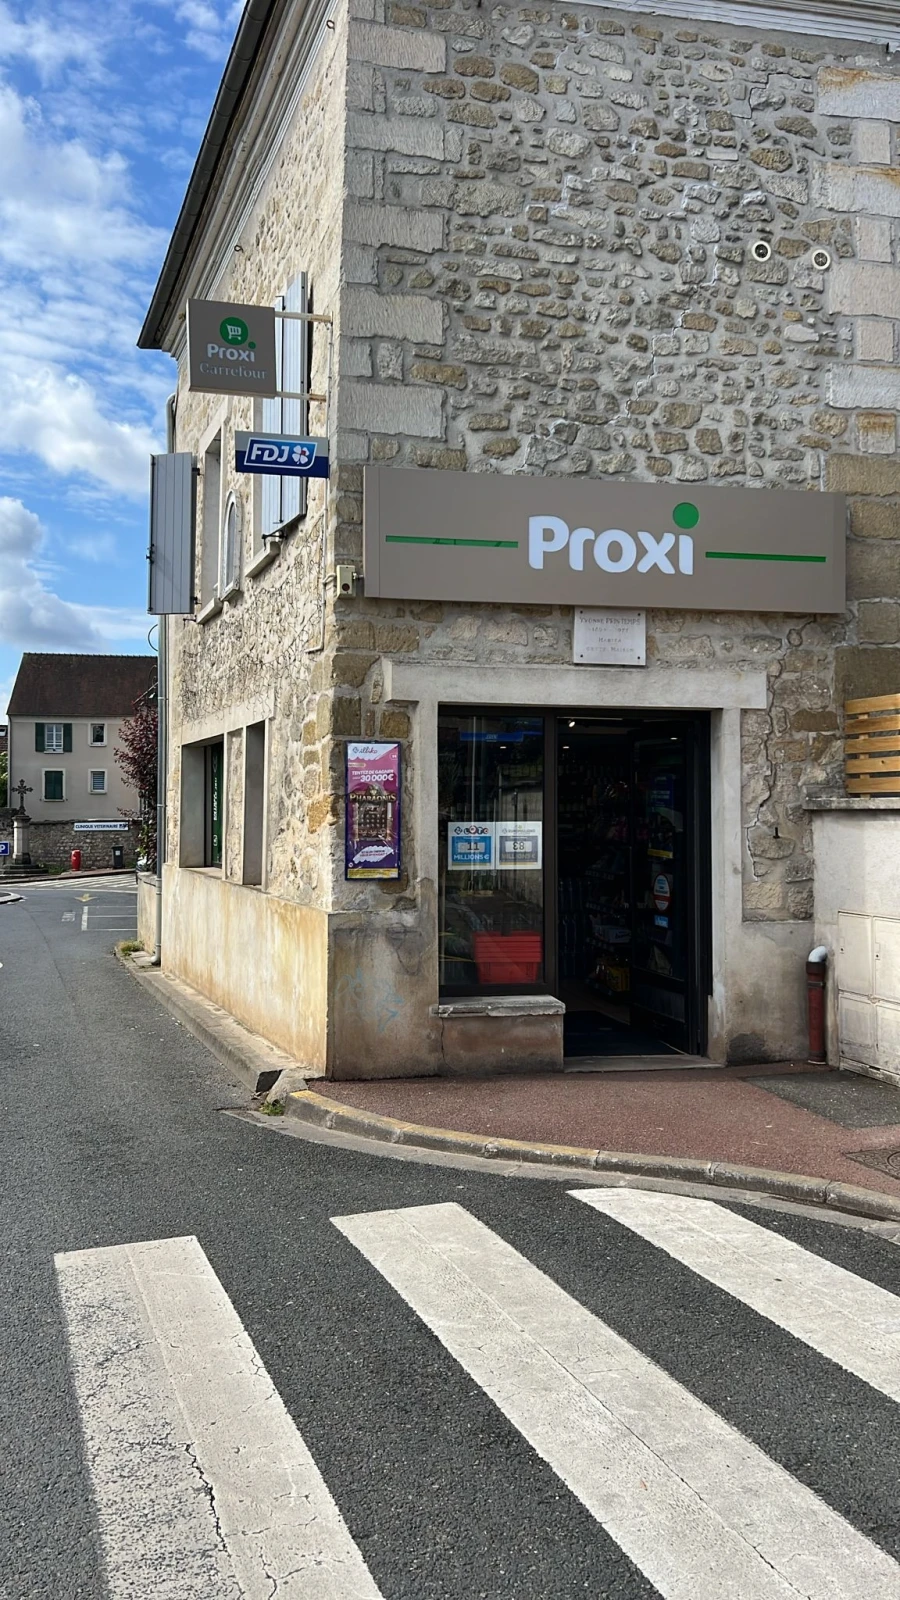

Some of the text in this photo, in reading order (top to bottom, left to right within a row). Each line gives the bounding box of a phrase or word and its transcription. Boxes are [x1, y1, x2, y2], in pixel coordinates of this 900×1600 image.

[207, 342, 256, 362] Proxi
[199, 362, 268, 380] Carrefour
[250, 443, 289, 463] FDJ
[528, 502, 699, 575] Proxi
[467, 842, 479, 851] 11
